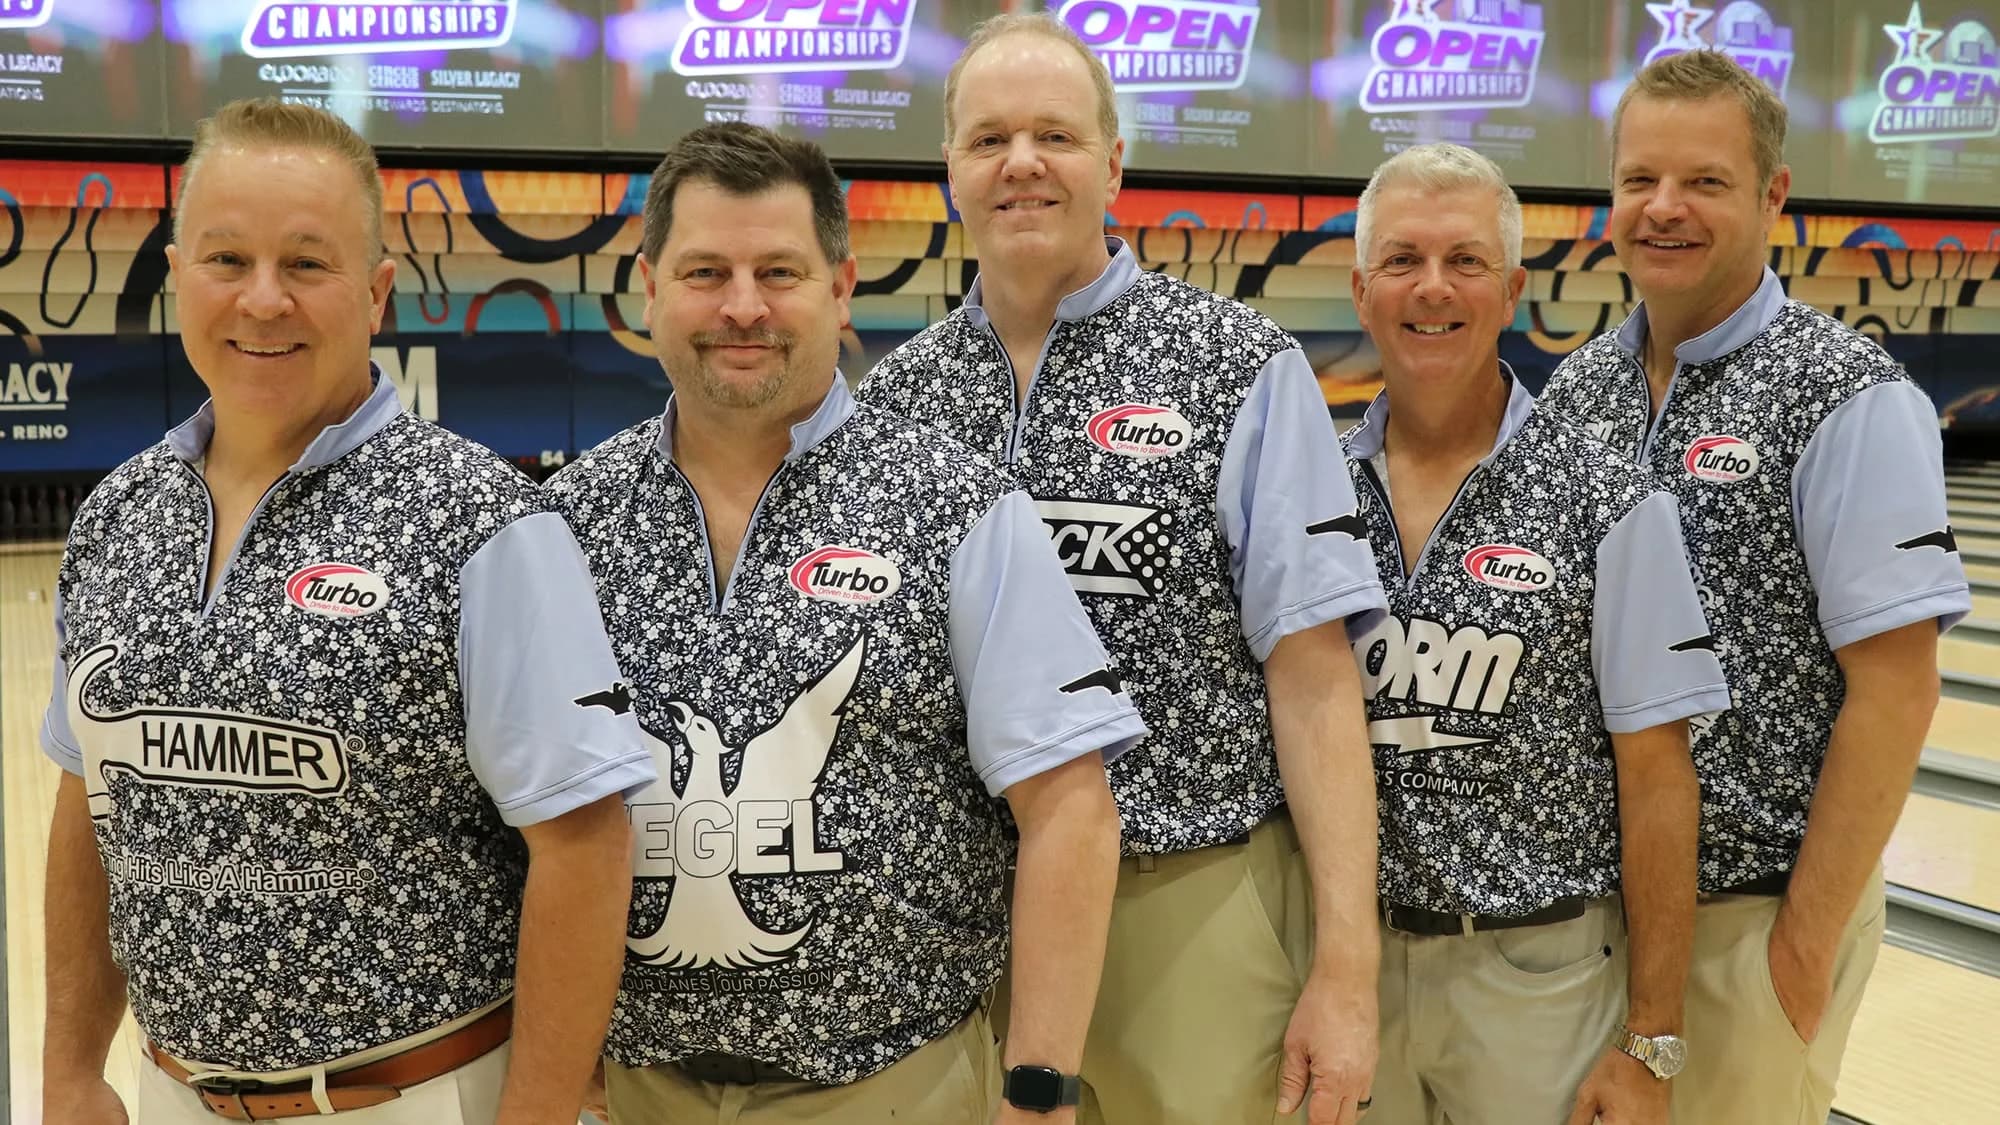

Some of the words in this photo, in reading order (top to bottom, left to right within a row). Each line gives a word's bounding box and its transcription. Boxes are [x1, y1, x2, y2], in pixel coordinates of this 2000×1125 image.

[267, 6, 498, 39] CHAMPIONSHIPS
[1065, 0, 1252, 48] OPEN
[694, 29, 893, 59] CHAMPIONSHIPS
[1378, 25, 1538, 68] OPEN
[9, 54, 63, 73] LEGACY
[431, 69, 473, 88] SILVER
[1102, 52, 1235, 78] AMPIONSHIPS
[1376, 73, 1524, 98] CHAMPIONSHIPS
[1880, 107, 1995, 131] CHAMPIONSHIPS
[0, 361, 74, 403] ACY
[12, 423, 69, 441] RENO
[1110, 417, 1184, 447] Turbo
[1697, 447, 1751, 474] Turbo
[809, 561, 889, 594] Turbo
[1483, 555, 1547, 585] Turbo
[305, 576, 377, 608] Turbo
[1400, 772, 1490, 796] COMPANY
[629, 799, 844, 878] EGEL
[127, 856, 163, 884] Hits
[167, 860, 213, 890] Like
[216, 866, 241, 890] A
[659, 978, 711, 991] LANES
[720, 978, 753, 992] OUR
[758, 971, 832, 990] PASSION
